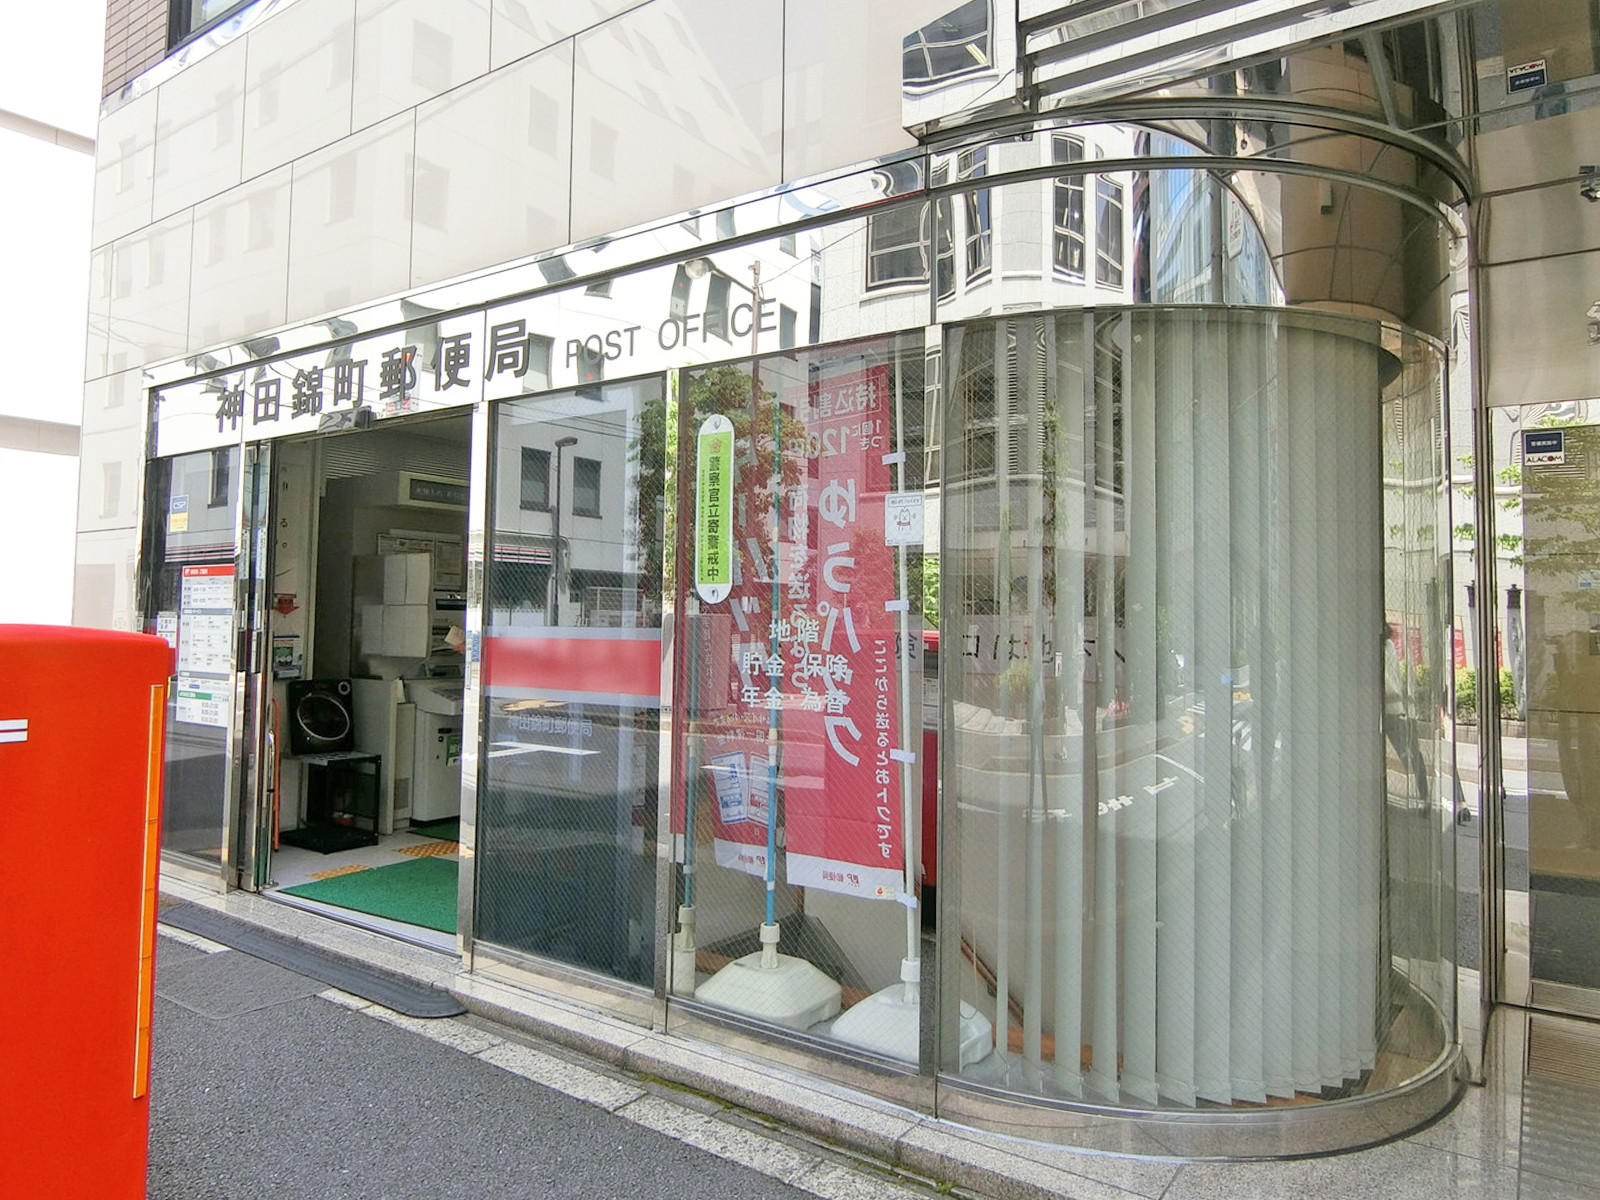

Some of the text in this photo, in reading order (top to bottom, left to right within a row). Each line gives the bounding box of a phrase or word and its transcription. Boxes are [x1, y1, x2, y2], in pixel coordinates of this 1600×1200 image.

[566, 297, 777, 368] POST OFFICE
[216, 319, 531, 433] 神田錦町郵便局
[707, 456, 721, 582] 警察官立寄警戒中
[768, 618, 820, 643] 地階
[741, 652, 850, 682] 貯金 保険
